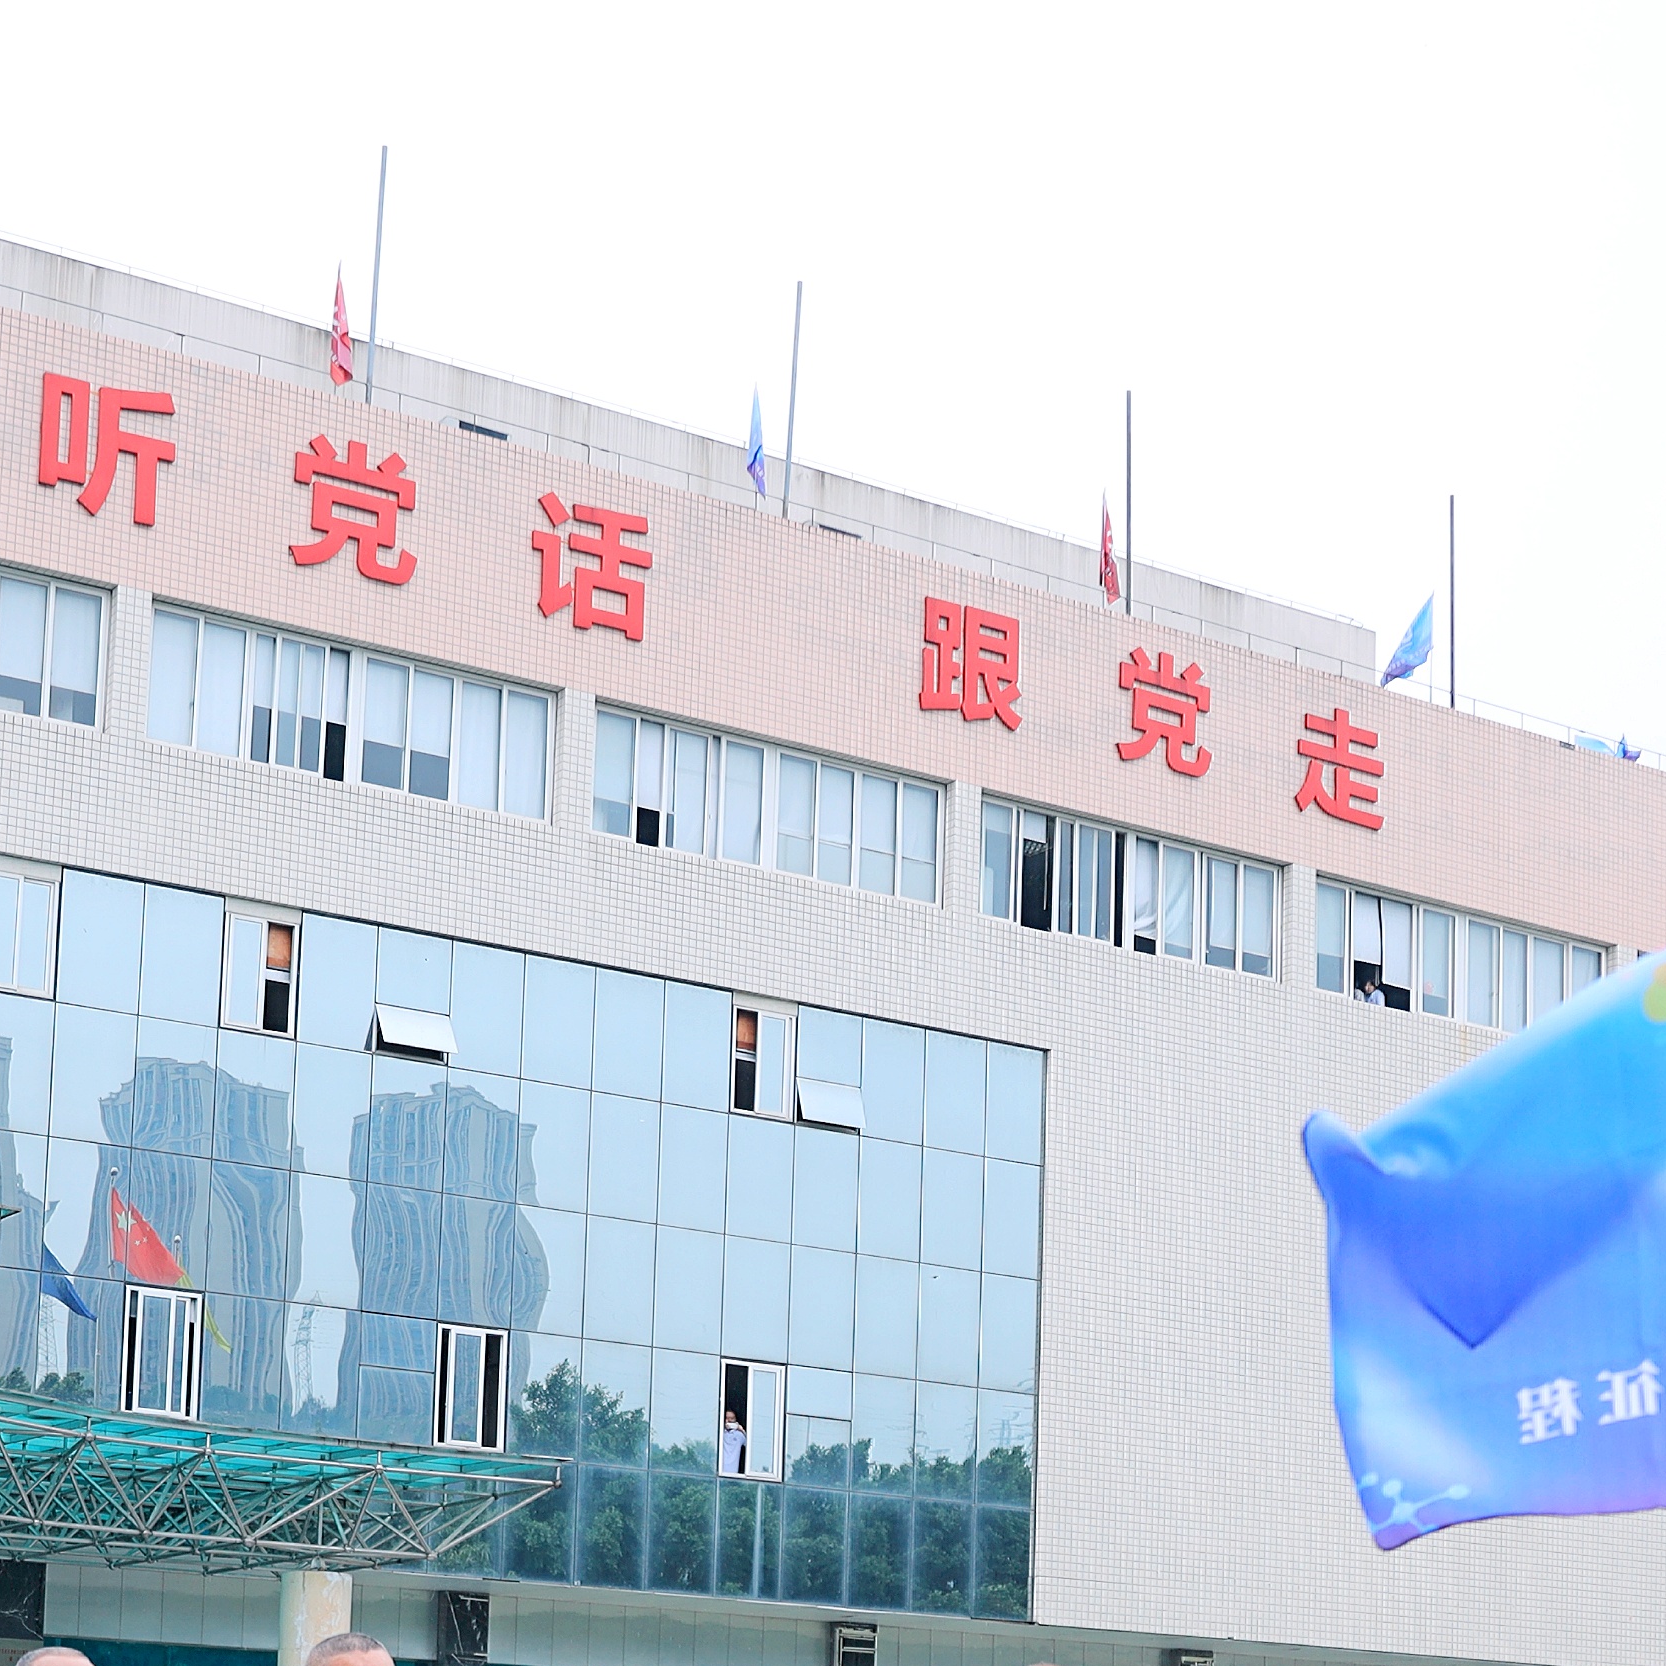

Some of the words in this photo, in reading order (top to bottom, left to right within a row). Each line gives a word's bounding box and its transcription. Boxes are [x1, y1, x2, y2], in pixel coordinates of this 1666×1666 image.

[37, 371, 653, 641] 听党话
[920, 597, 1386, 831] 跟党走
